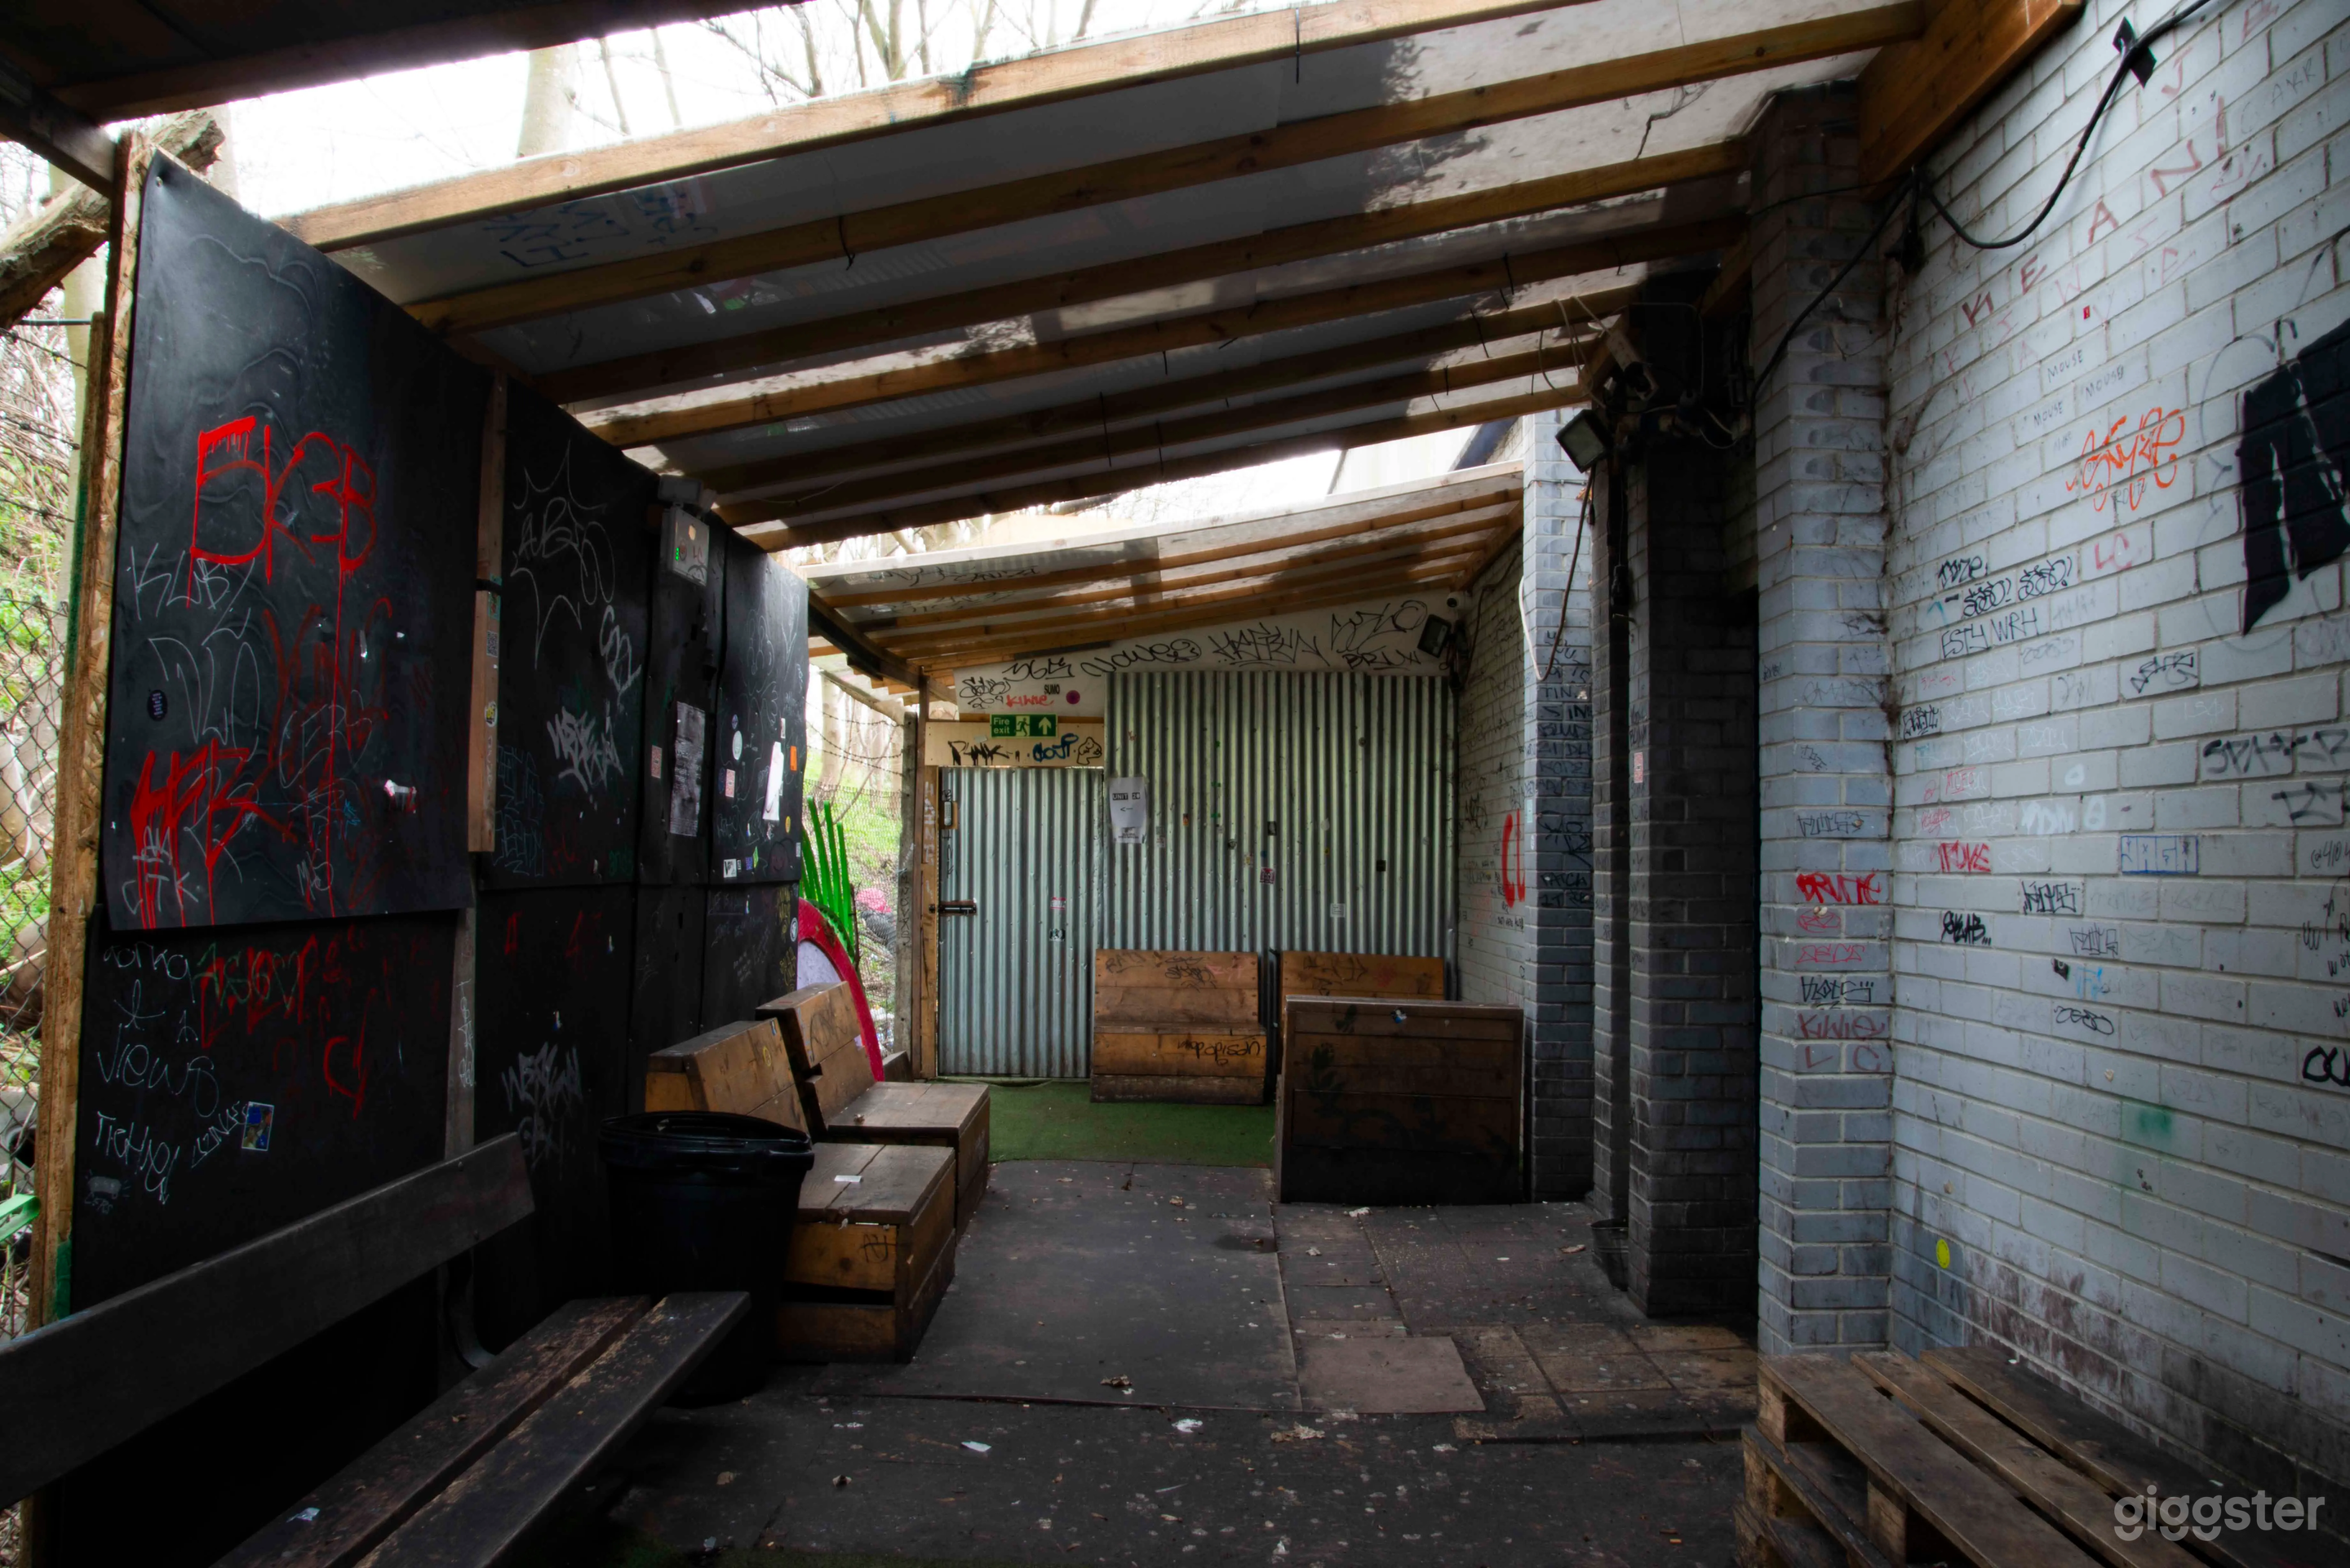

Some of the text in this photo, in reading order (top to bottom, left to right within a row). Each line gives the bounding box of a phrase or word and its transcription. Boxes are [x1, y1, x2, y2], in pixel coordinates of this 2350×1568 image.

[2046, 348, 2083, 383] MOUSE
[2033, 400, 2064, 427] MOUSE
[993, 717, 1010, 726] Fire
[993, 726, 1010, 734] exit
